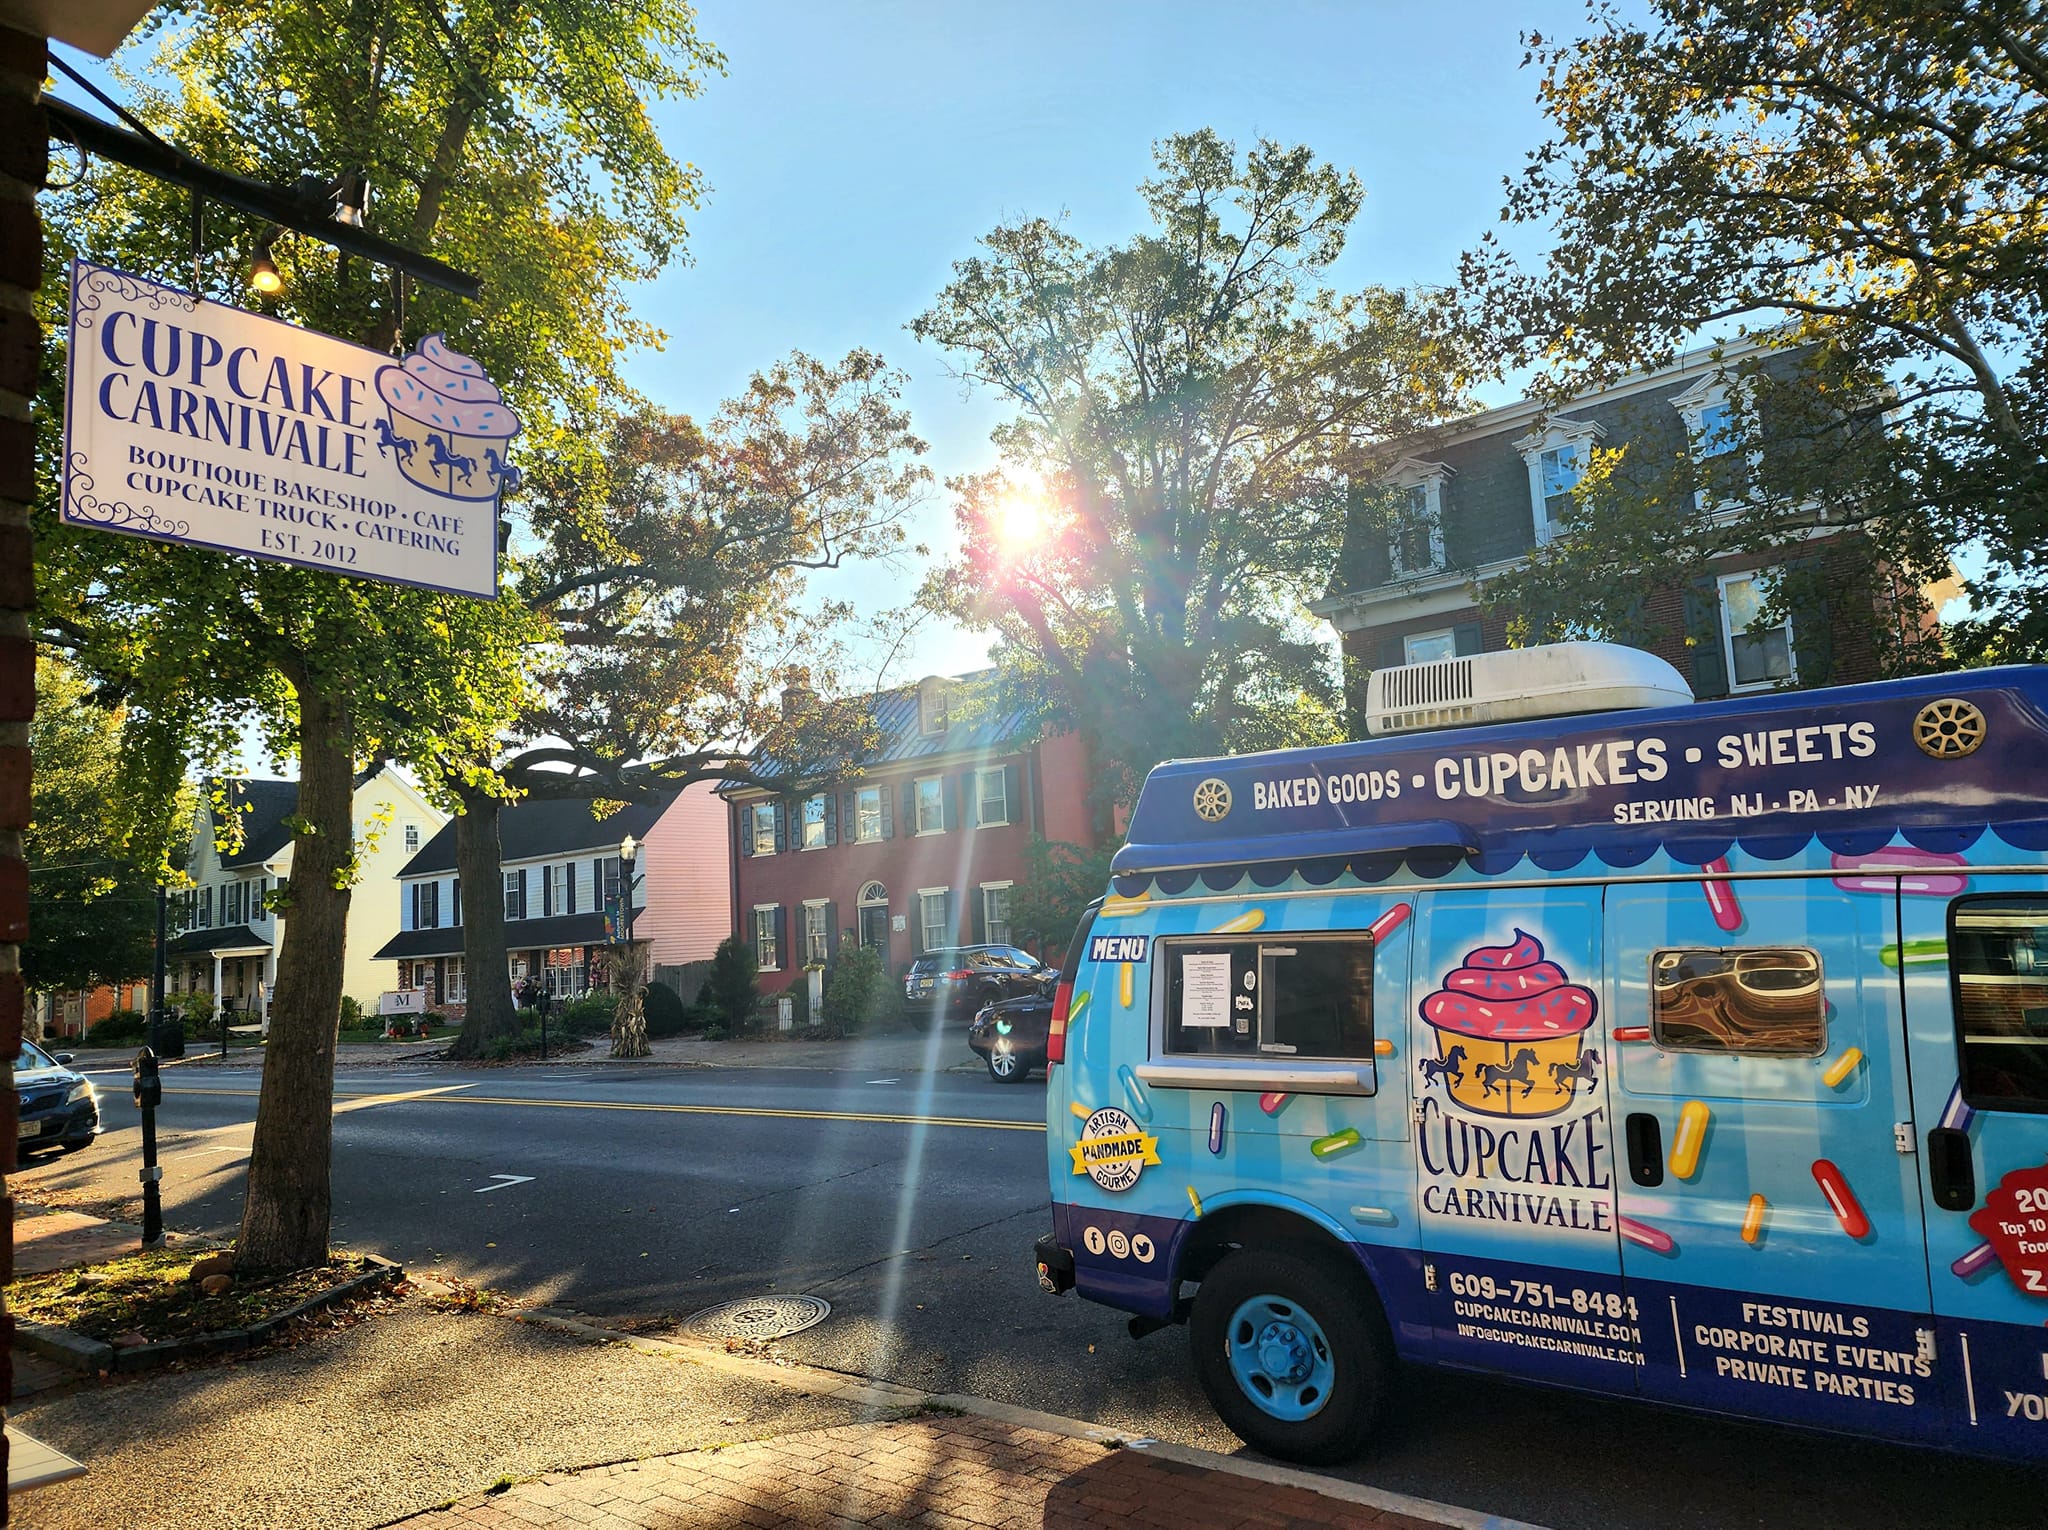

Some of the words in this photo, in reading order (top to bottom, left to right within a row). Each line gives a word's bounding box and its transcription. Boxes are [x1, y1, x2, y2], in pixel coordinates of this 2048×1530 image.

[101, 311, 367, 430] CUPCAKE
[100, 372, 367, 478] CARNIVALE
[128, 445, 267, 491] BOUTIQUE
[273, 478, 397, 520] BAKESHOP
[413, 510, 464, 536] CAFÉ
[126, 471, 250, 513] CUPCAKE
[254, 497, 338, 531] TRUCK
[355, 520, 460, 556] CATERING
[261, 529, 305, 555] EST.
[312, 540, 357, 565] 2012
[1253, 776, 1320, 810] BAKED
[1327, 769, 1400, 803] GOODS
[1434, 738, 1669, 800] CUPCAKES
[1717, 721, 1877, 769] SWEETS
[1613, 797, 1715, 824] SERVING
[1731, 792, 1764, 817] NJ
[1788, 789, 1820, 813] PA
[1845, 784, 1881, 810] NY
[1092, 938, 1145, 961] MENU
[1088, 1111, 1128, 1134] ARTISAN
[1420, 1096, 1610, 1190] CUPCAKE
[1082, 1139, 1144, 1161] HANDMADE
[1096, 1165, 1137, 1188] GOURMET
[1423, 1185, 1612, 1232] CARNIVALE
[1999, 1220, 2027, 1237] Top
[2028, 1218, 2047, 1233] 10
[2018, 1240, 2048, 1254] Foo
[1450, 1272, 1639, 1321] 609-751-8484
[1454, 1300, 1642, 1344] CUPCAKECARNIVALE.COM
[1742, 1302, 1869, 1338] FESTIVALS
[1457, 1323, 1646, 1367] INFO@CUPCAKECARNIVALE.COM
[1695, 1325, 1829, 1363] CORPORATE
[1835, 1344, 1932, 1378] EVENTS
[1716, 1356, 1808, 1390] PRIVATE
[1814, 1370, 1915, 1406] PARTIES
